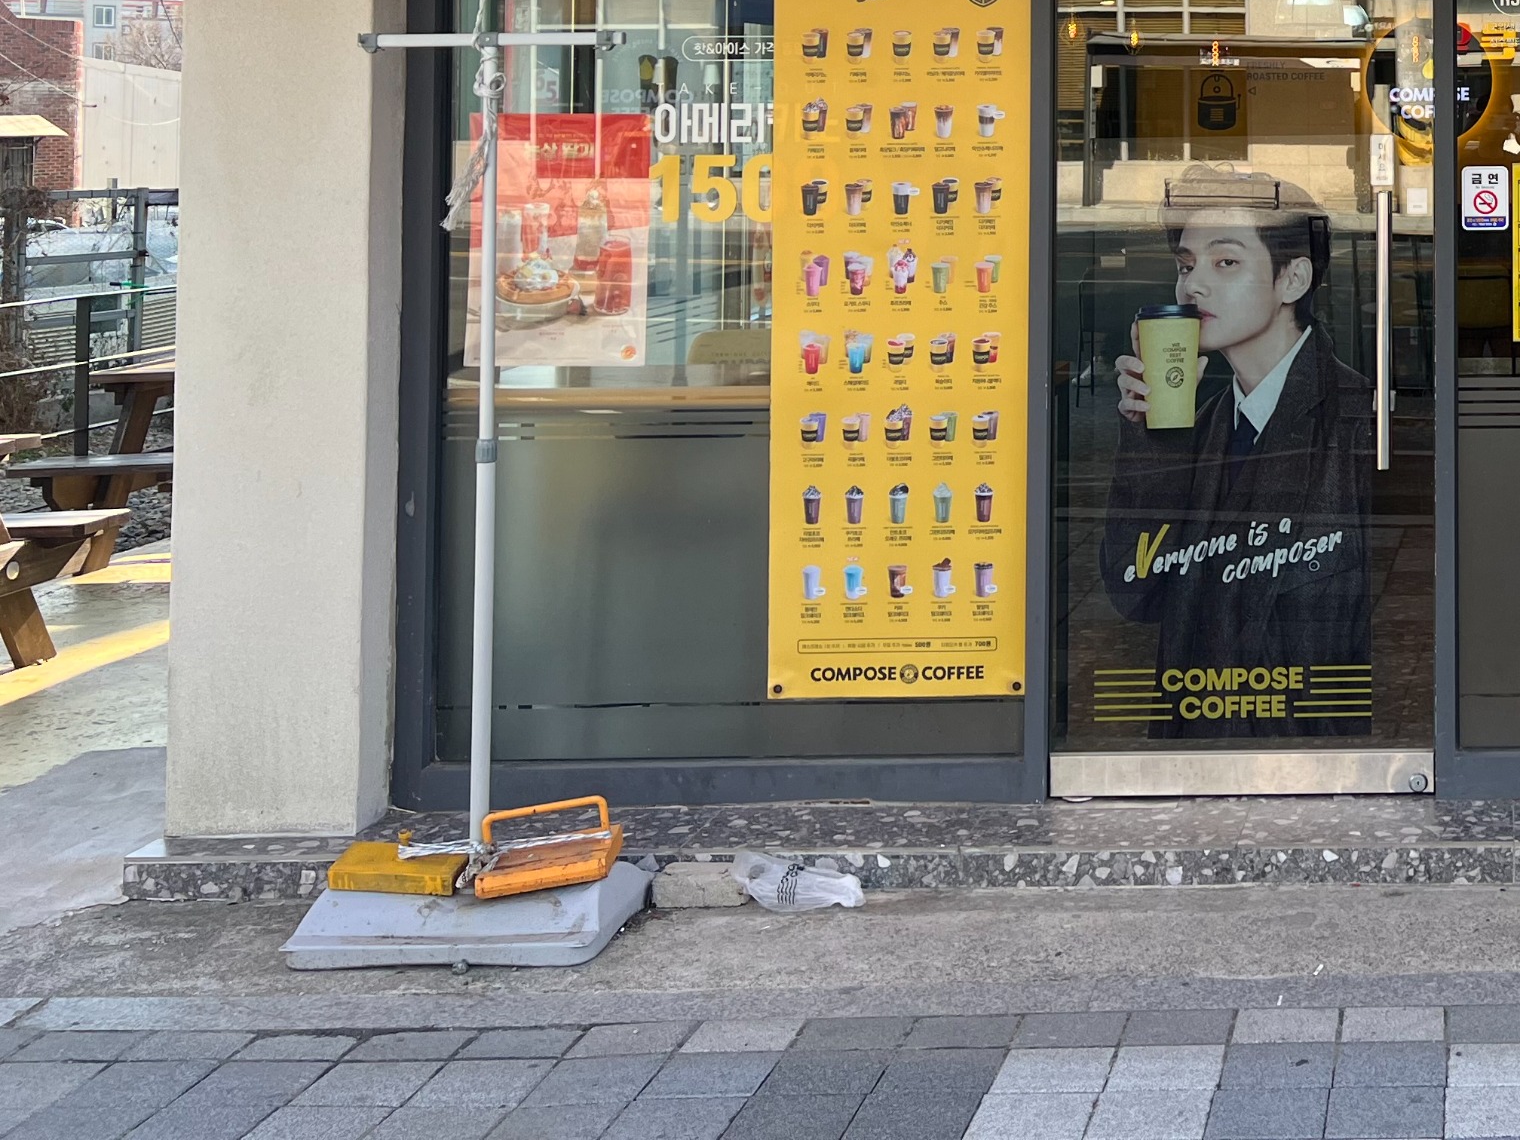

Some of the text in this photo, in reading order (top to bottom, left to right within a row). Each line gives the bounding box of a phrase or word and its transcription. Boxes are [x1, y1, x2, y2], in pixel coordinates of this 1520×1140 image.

[693, 41, 750, 56] 핫&아이스
[1246, 71, 1325, 81] ROASTED COFFEE
[654, 102, 774, 143] 아메리
[1247, 520, 1269, 547] is
[1278, 517, 1292, 534] a
[1221, 529, 1344, 584] composer
[810, 665, 985, 682] COMPOSE COFFEE
[1161, 666, 1304, 691] COMPOSE
[1178, 694, 1287, 720] COFFEE
